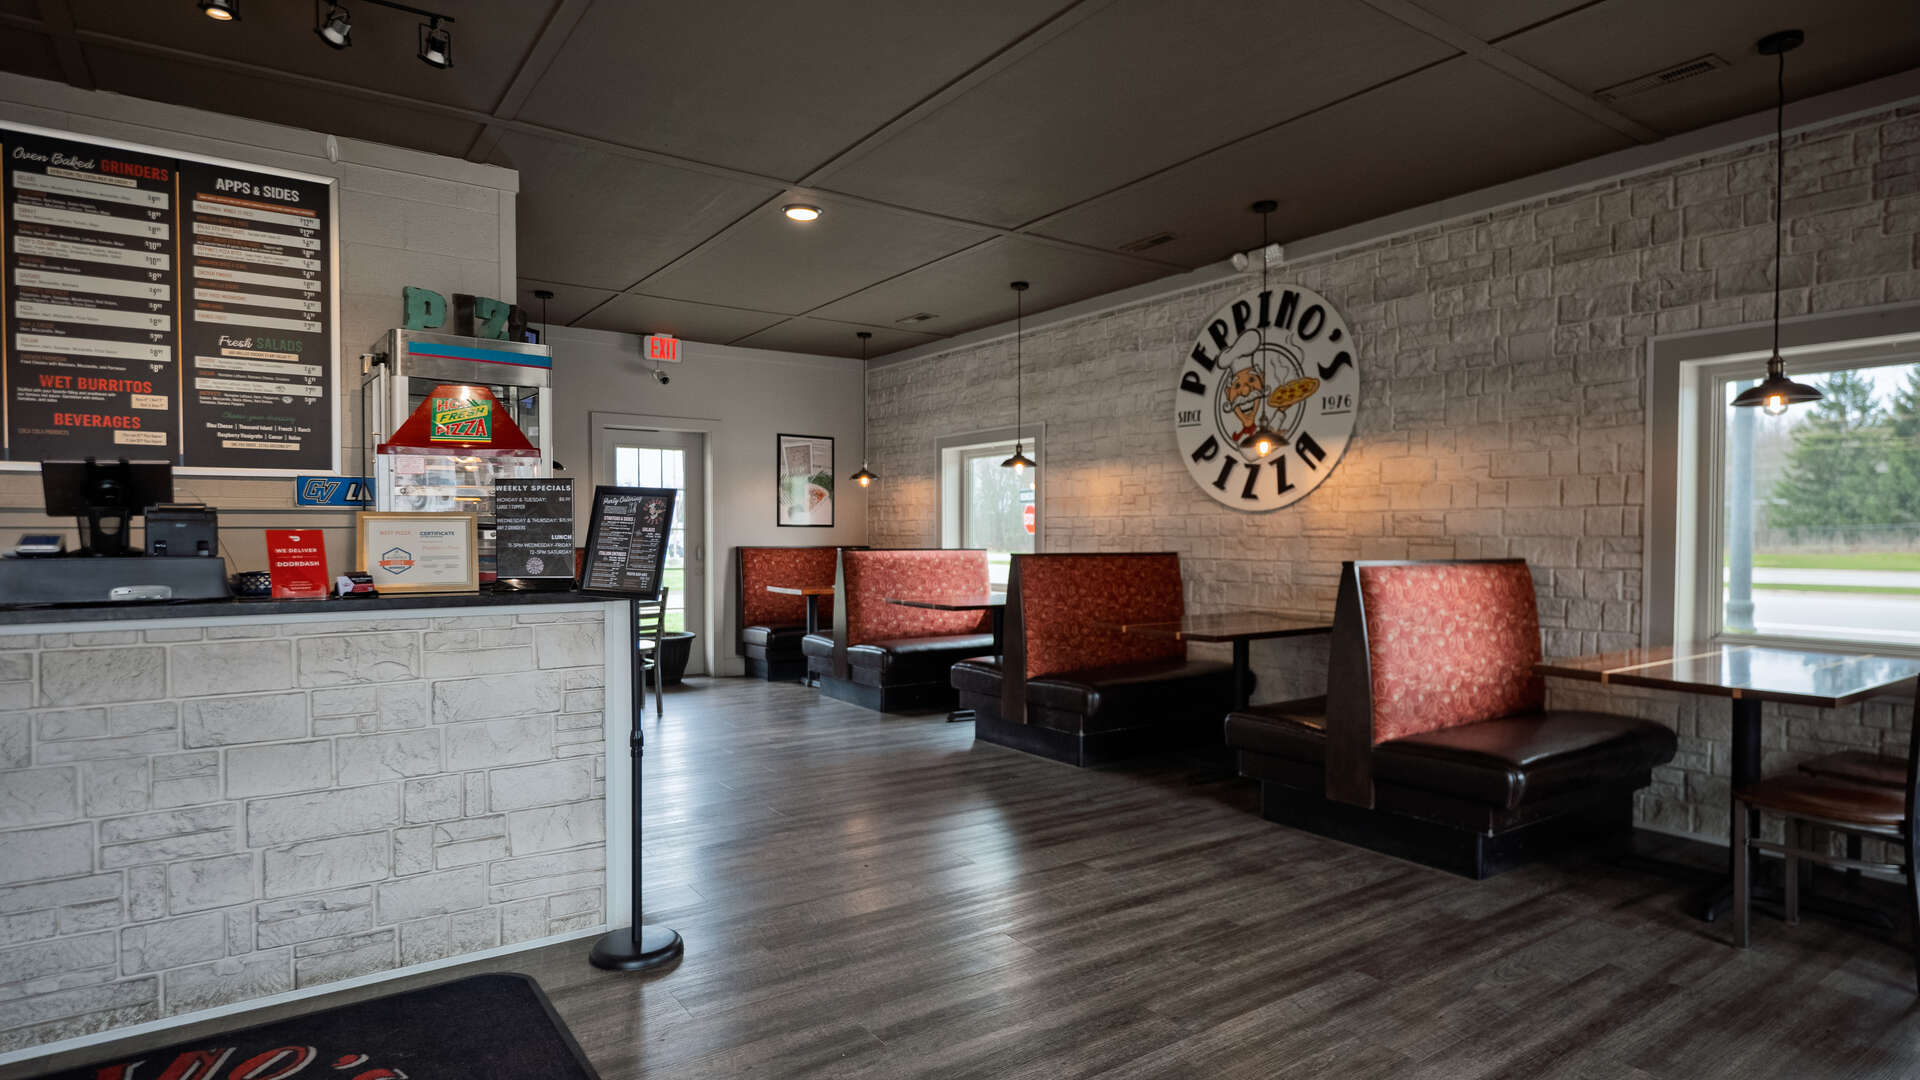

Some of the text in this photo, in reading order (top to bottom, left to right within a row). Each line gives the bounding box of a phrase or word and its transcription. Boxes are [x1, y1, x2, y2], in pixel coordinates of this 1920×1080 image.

[12, 147, 48, 162] Oven
[51, 153, 95, 170] Baked
[101, 159, 169, 181] GRINDERS
[216, 178, 300, 202] APPS & SIDES
[219, 335, 303, 353] Fresh SALADS
[650, 336, 678, 361] EXIT
[1180, 290, 1353, 396] PEPPINO'S
[39, 374, 152, 394] WET BURRITOS
[1322, 394, 1352, 410] 1976
[53, 412, 141, 429] BEVERAGES
[440, 406, 487, 422] FRESH
[435, 418, 488, 437] PIZZA
[1191, 431, 1327, 500] PIZZA
